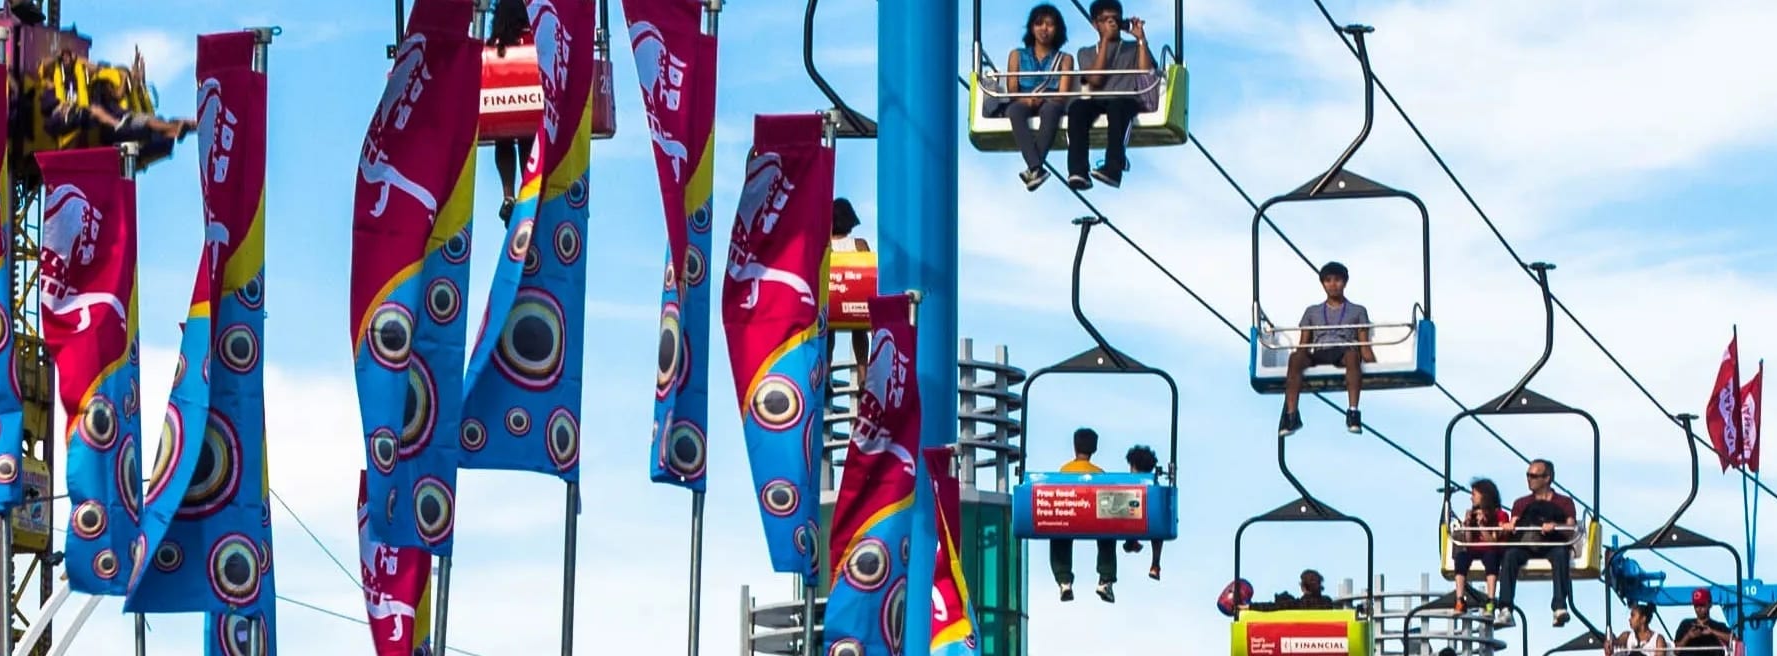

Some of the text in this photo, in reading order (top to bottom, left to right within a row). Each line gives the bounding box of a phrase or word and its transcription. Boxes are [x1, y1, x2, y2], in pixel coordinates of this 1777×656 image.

[483, 93, 542, 106] FINANCI
[1053, 498, 1091, 509] seriously,
[1036, 507, 1053, 516] free
[1745, 586, 1757, 595] 10
